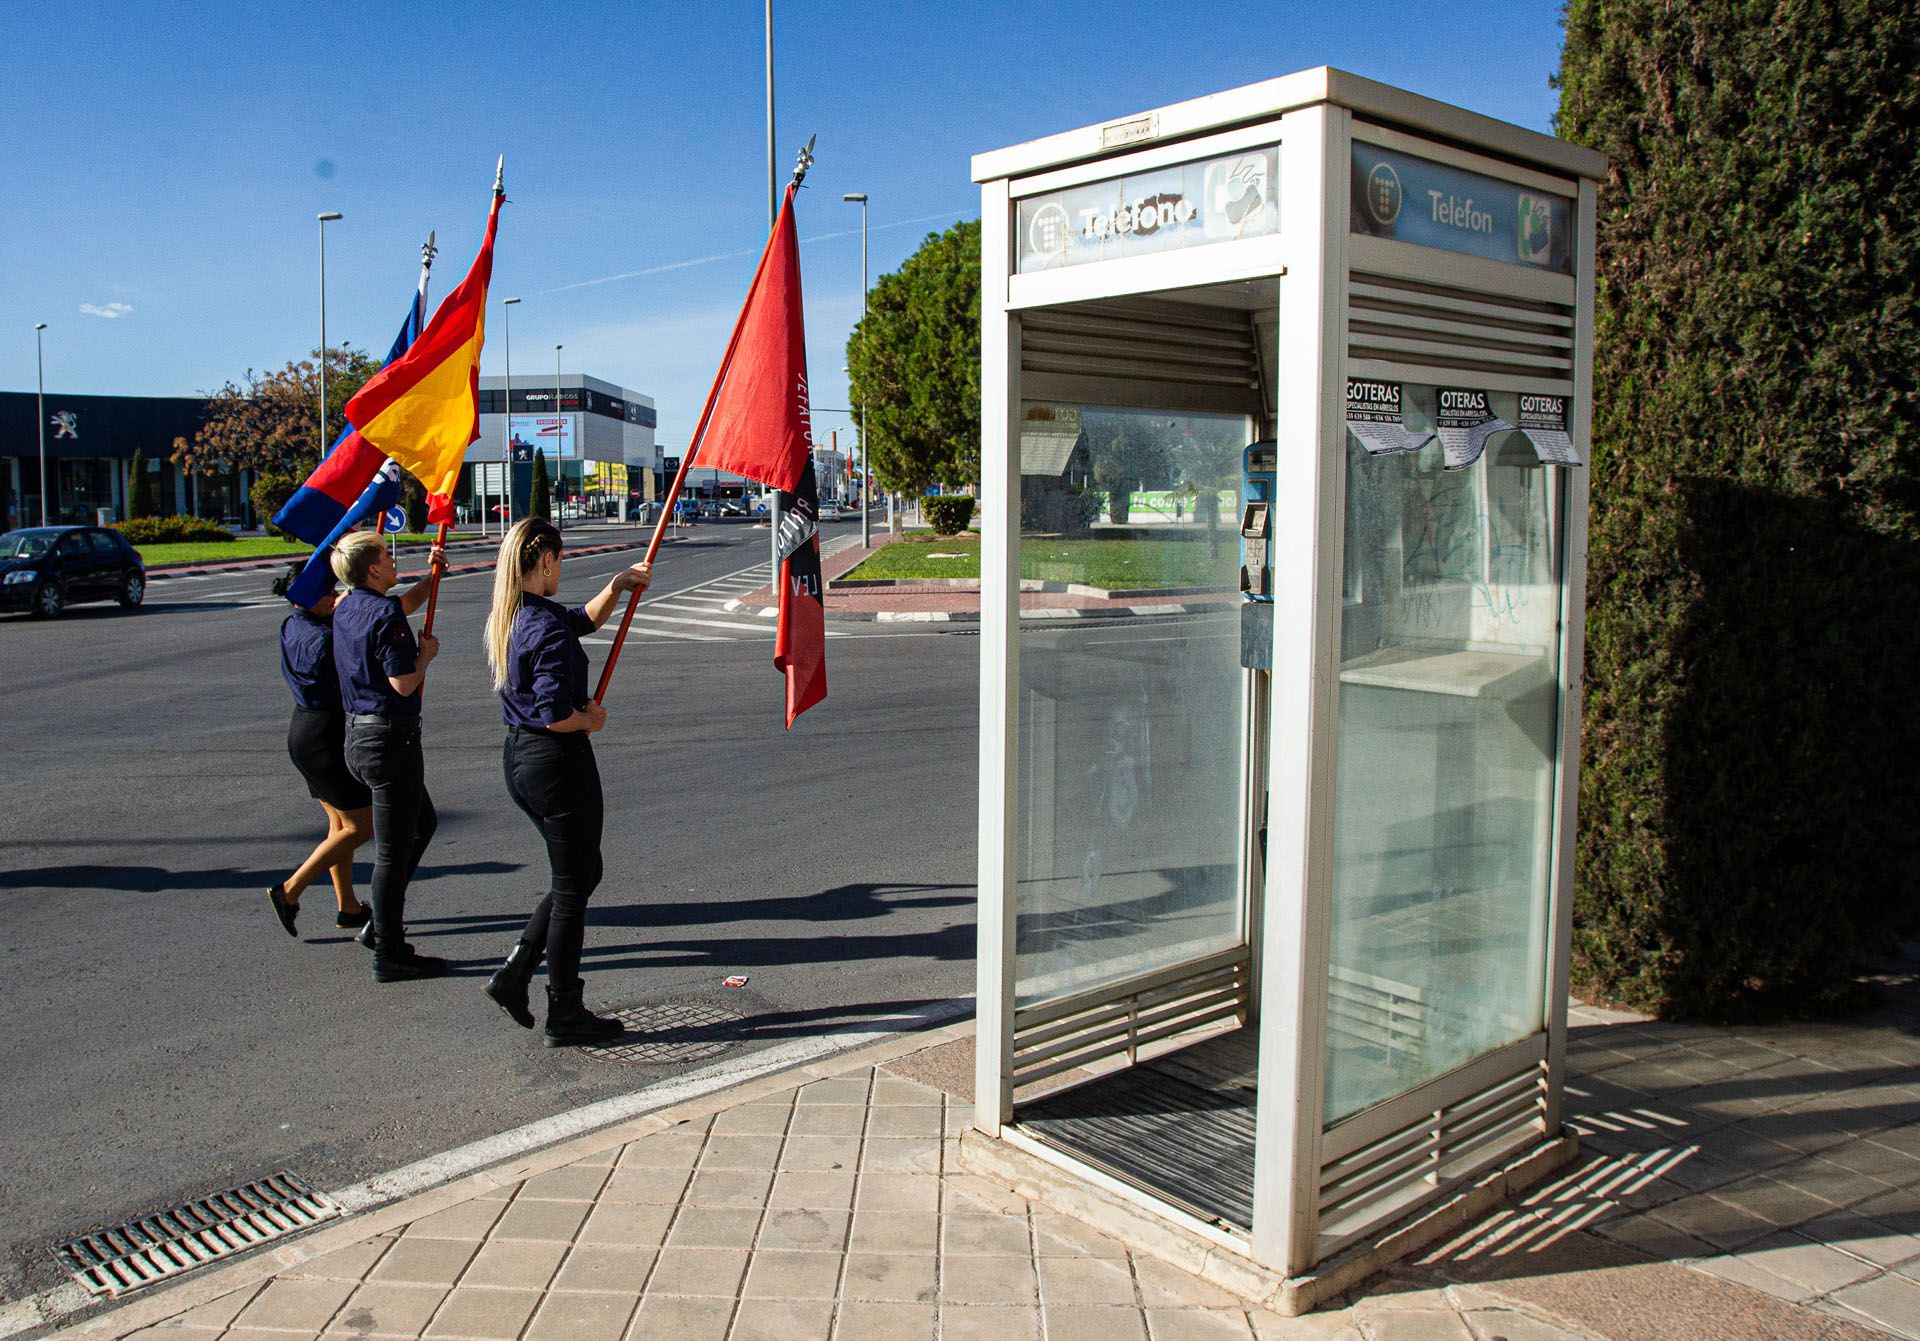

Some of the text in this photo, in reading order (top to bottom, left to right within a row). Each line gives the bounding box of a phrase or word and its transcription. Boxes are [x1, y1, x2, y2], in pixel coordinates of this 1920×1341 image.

[1346, 381, 1400, 403] GOTERAS
[1441, 391, 1485, 409] OTERAS
[1521, 396, 1563, 414] GOTERAS
[1133, 496, 1145, 508] tu
